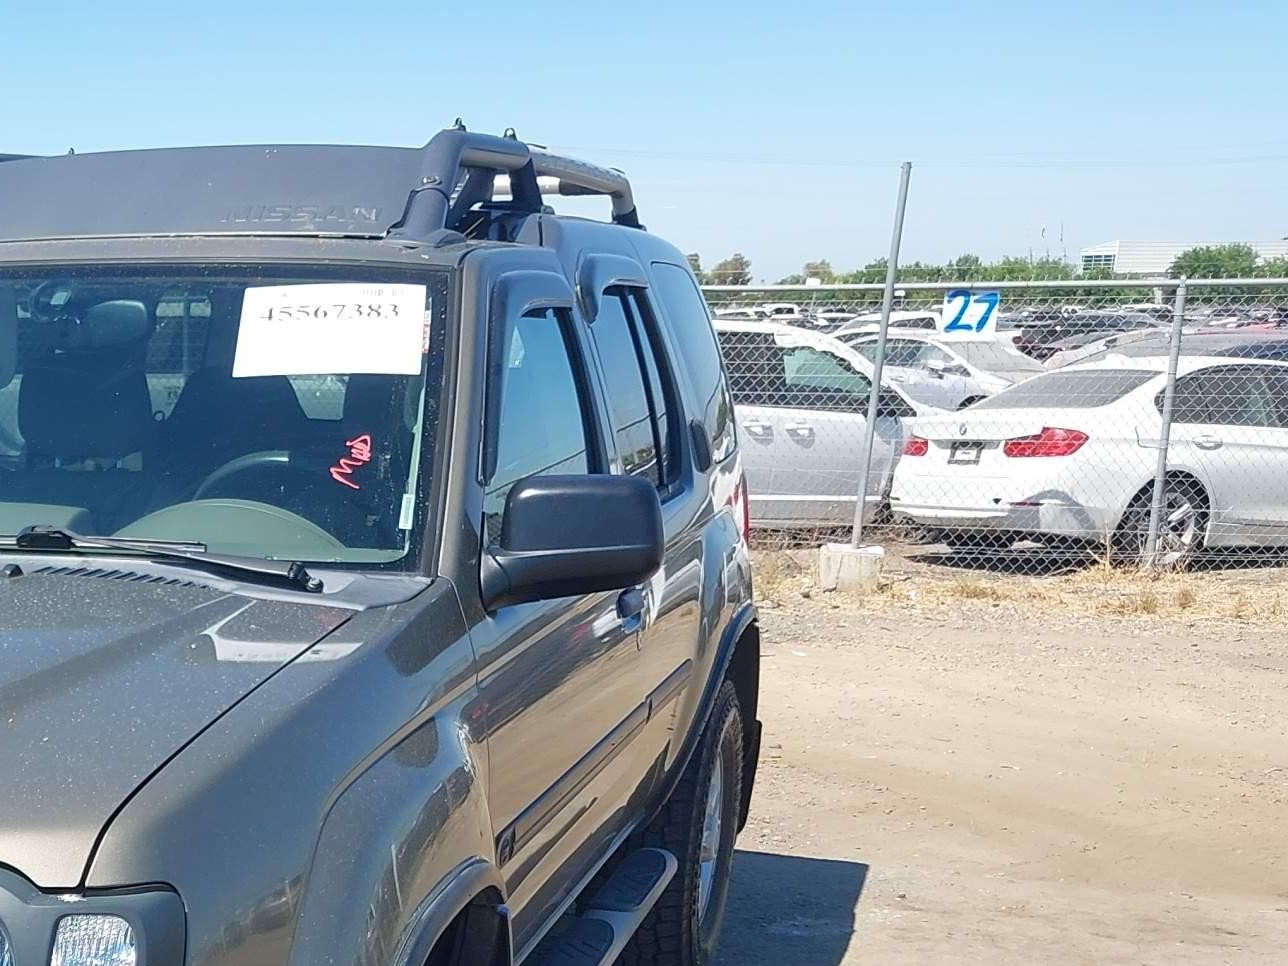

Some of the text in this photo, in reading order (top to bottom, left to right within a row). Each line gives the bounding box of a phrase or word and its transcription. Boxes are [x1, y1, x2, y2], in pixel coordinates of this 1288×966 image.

[220, 205, 383, 223] NISSAN
[260, 303, 400, 322] 45567383
[944, 289, 999, 333] 27
